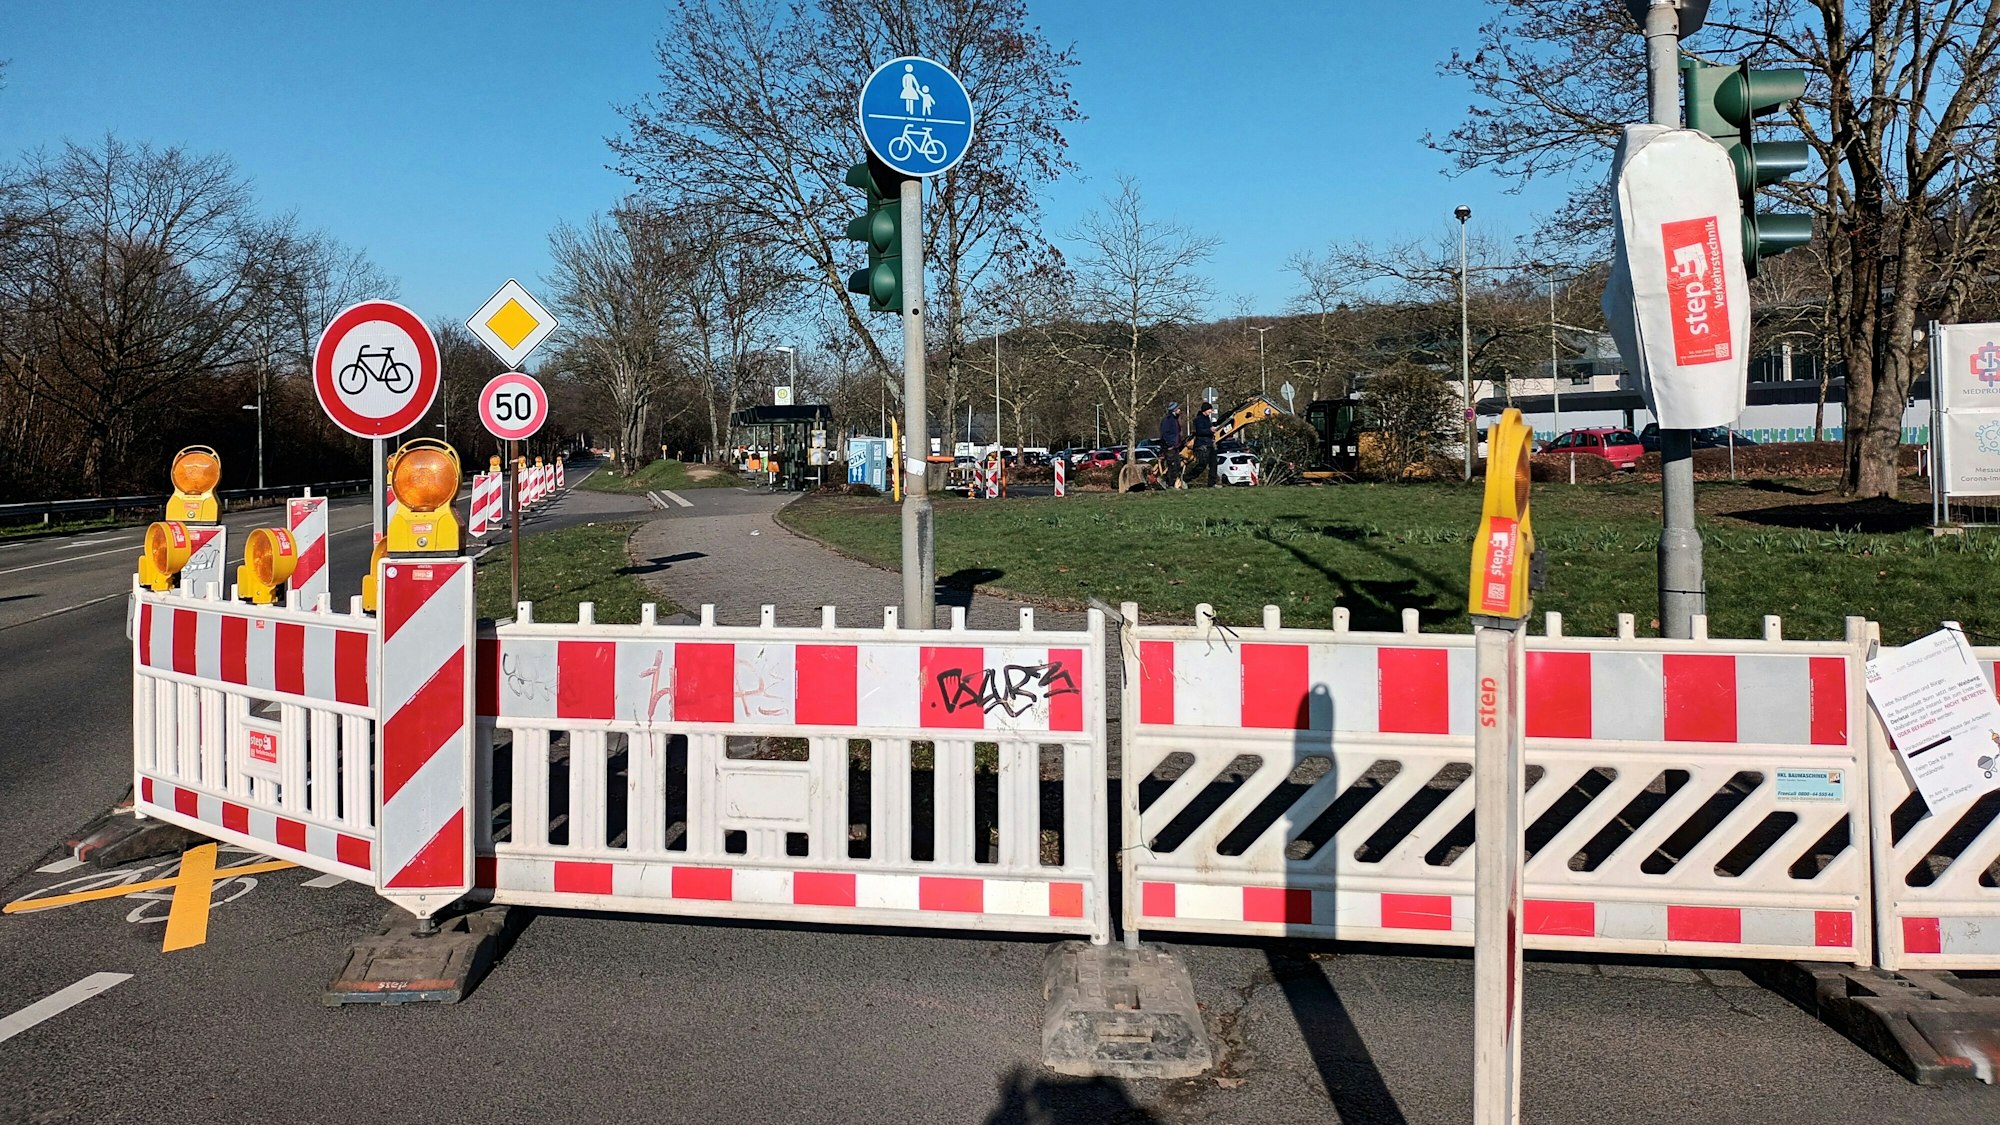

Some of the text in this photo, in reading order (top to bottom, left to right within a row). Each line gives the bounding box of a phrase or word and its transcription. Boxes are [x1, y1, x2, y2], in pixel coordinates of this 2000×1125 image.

[1705, 220, 1724, 309] Verkehrstechnik
[1685, 282, 1712, 336] step
[496, 393, 530, 420] 50
[1490, 549, 1506, 576] step
[1958, 675, 1980, 688] Waldweg
[1479, 677, 1496, 728] step
[1944, 699, 1959, 708] NICHT
[1961, 688, 1986, 701] BETRETEN
[1897, 729, 1910, 738] ODER
[1911, 718, 1936, 731] BEFAHREN
[250, 736, 263, 748] step
